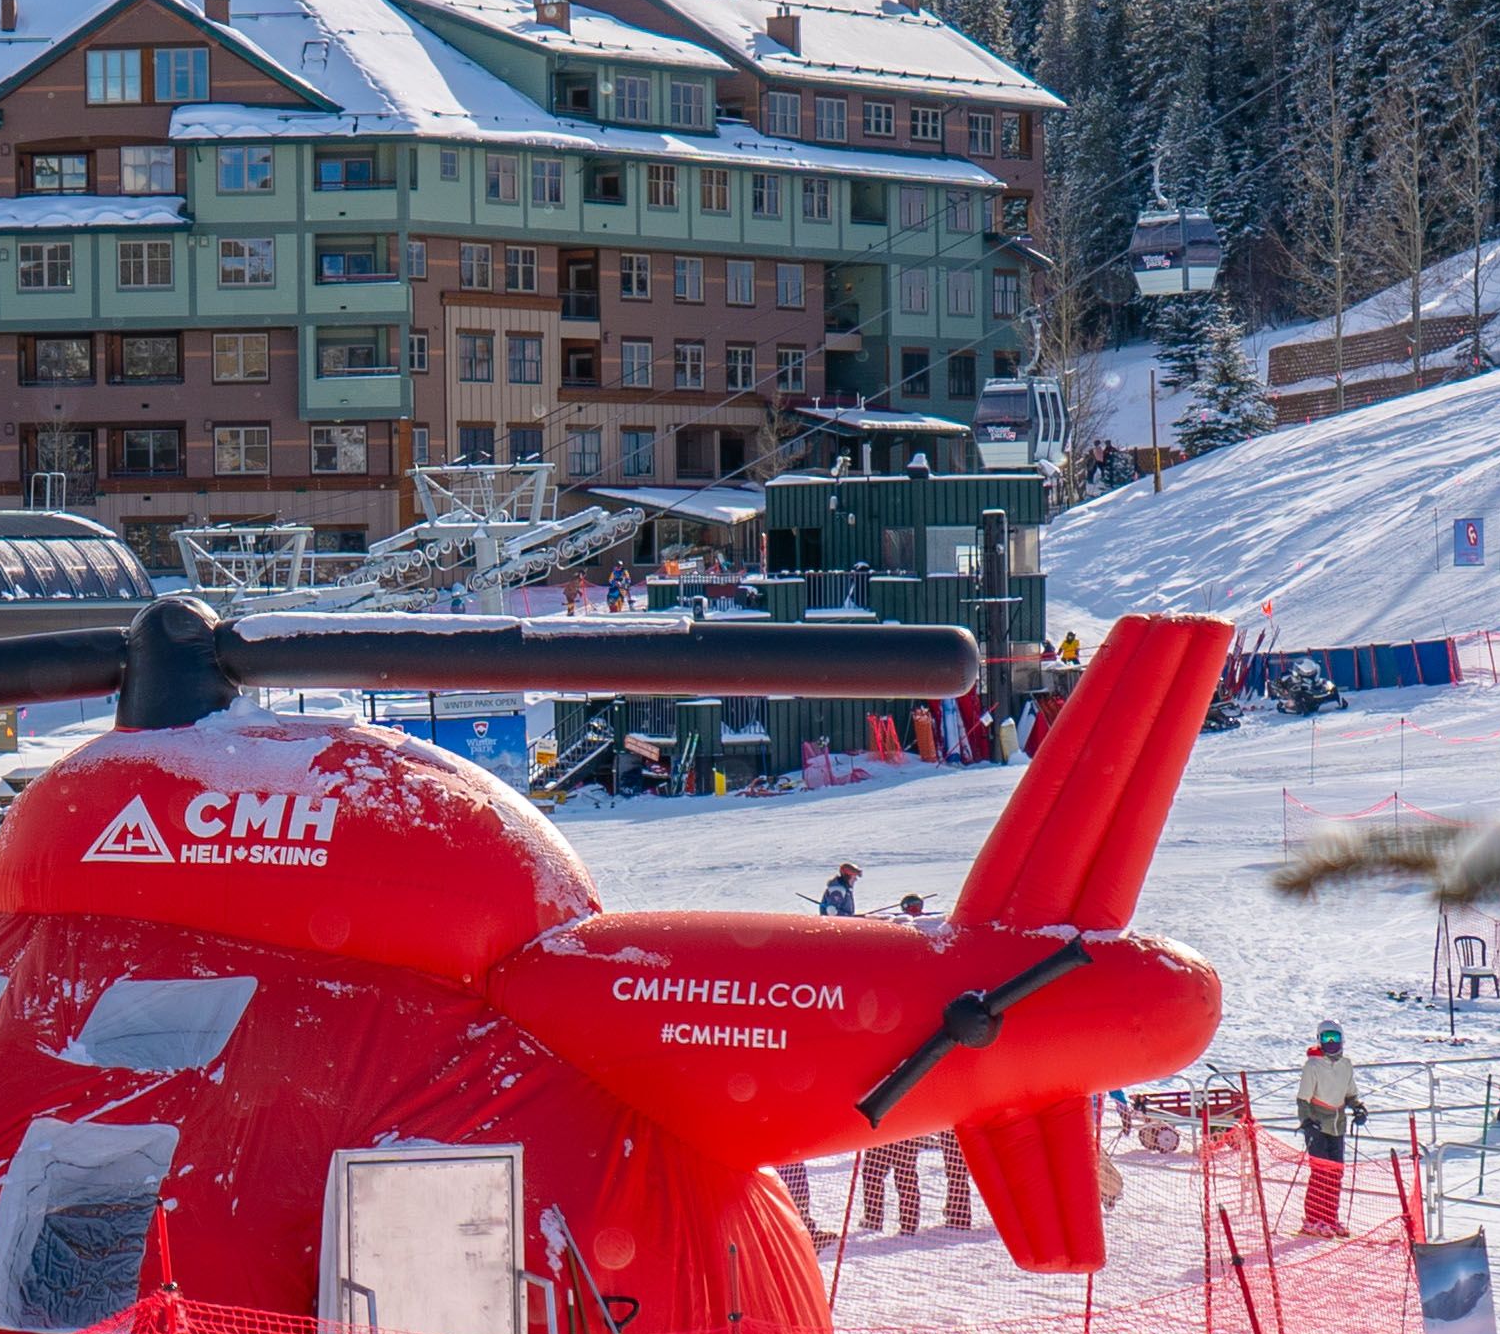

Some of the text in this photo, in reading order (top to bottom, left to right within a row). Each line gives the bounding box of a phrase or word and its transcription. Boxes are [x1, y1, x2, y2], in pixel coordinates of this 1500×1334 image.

[443, 698, 517, 710] WINTER PARK OPEN
[465, 738, 498, 748] Winter
[470, 745, 494, 755] park
[184, 791, 340, 842] CMH
[180, 844, 328, 867] HELI SKIING
[612, 976, 844, 1010] CMHHELI.COM
[661, 1023, 787, 1050] #CMHHELI
